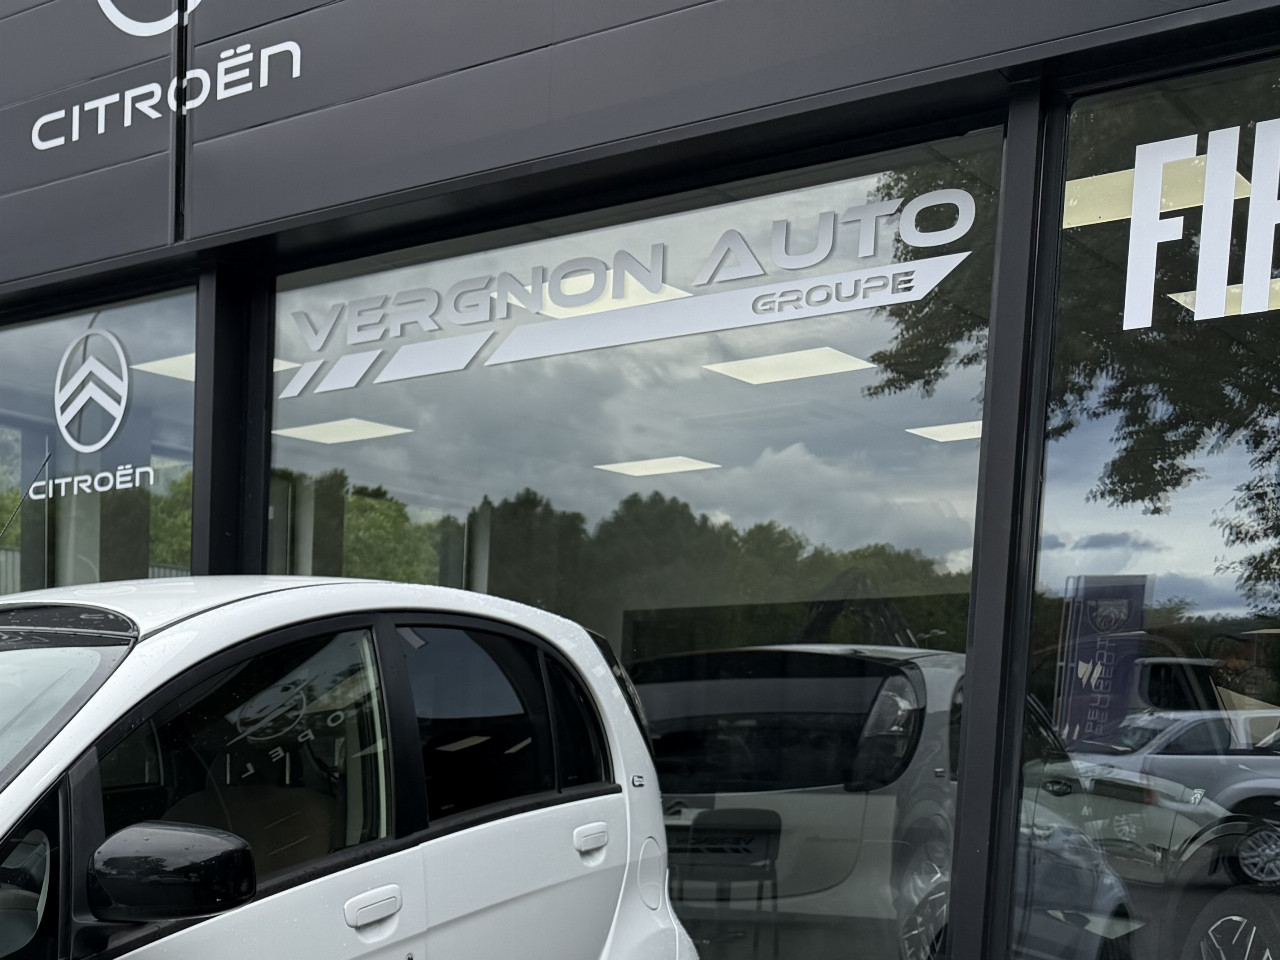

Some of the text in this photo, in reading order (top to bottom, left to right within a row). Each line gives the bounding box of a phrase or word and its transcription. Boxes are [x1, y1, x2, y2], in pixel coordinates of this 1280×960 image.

[291, 188, 976, 352] VERGNON AUTO
[751, 270, 916, 315] GROUPE
[28, 464, 154, 500] CITROËN
